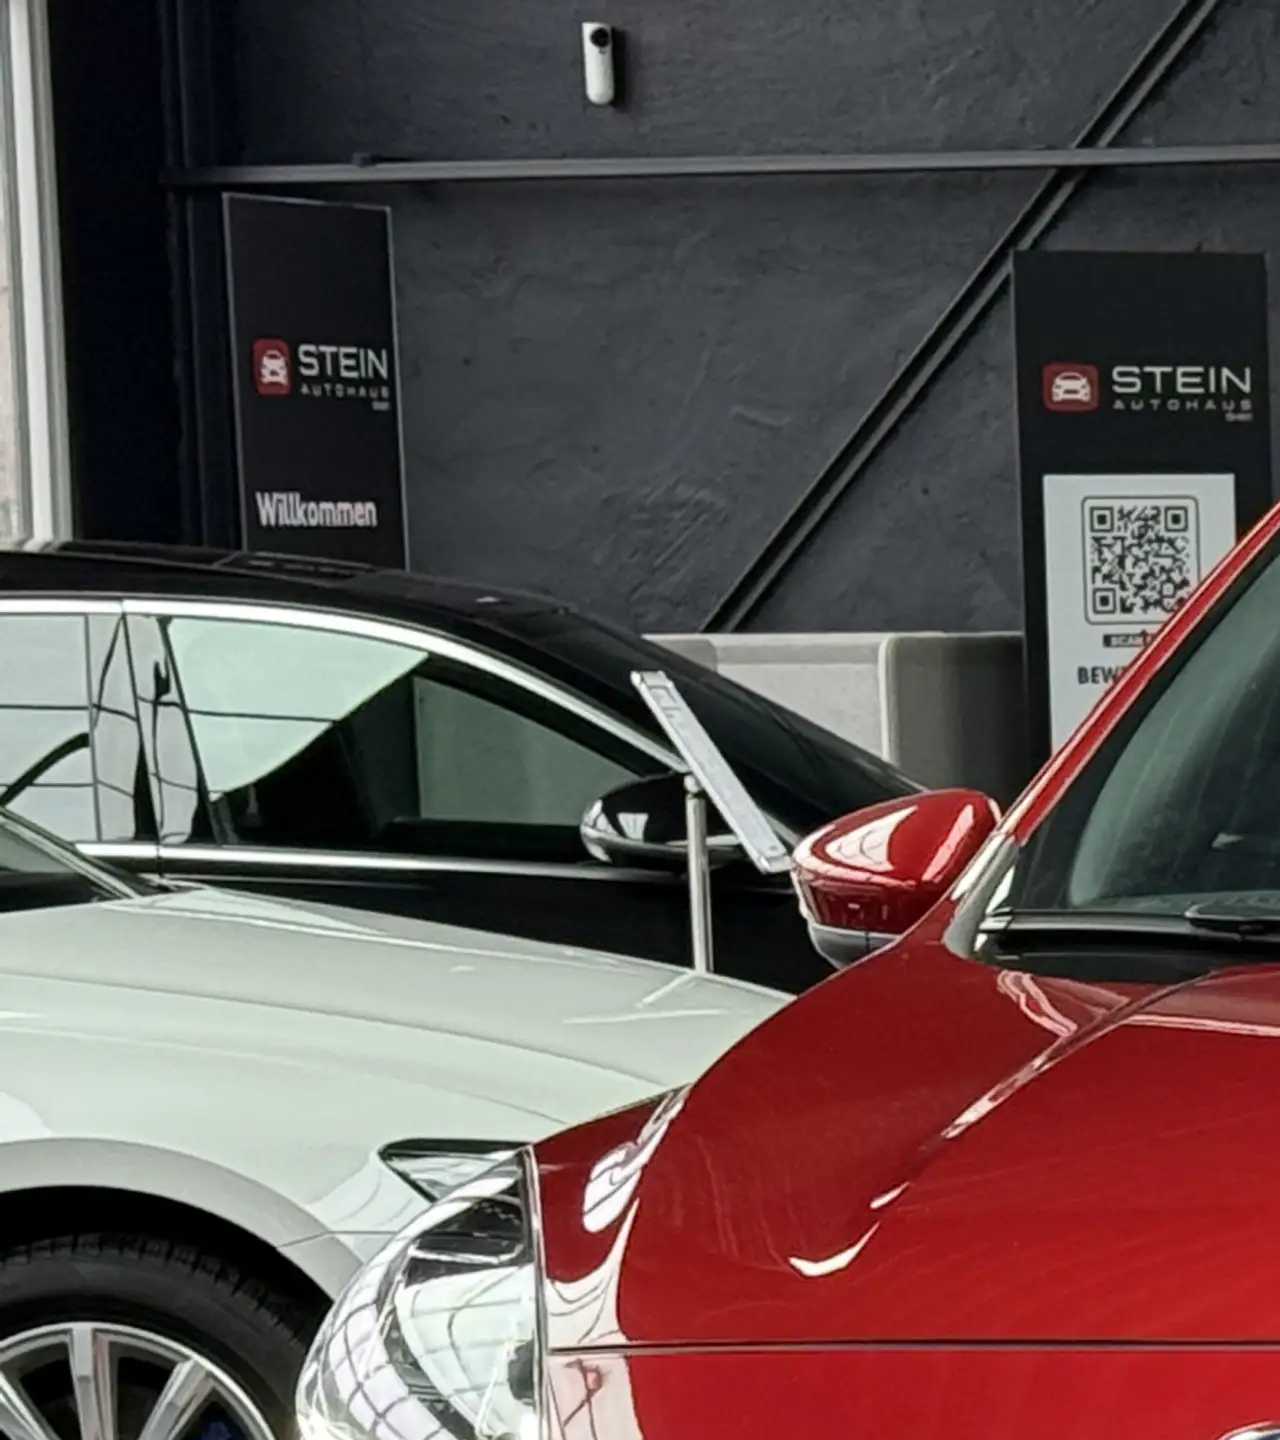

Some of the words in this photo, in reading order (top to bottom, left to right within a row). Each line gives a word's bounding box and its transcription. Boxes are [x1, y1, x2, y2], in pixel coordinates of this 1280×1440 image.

[298, 344, 388, 380] STEIN
[300, 382, 389, 399] AUTOHAUS
[1112, 366, 1252, 394] STEIN
[1113, 398, 1253, 411] AUTOHAUS
[256, 492, 378, 528] Willkommen
